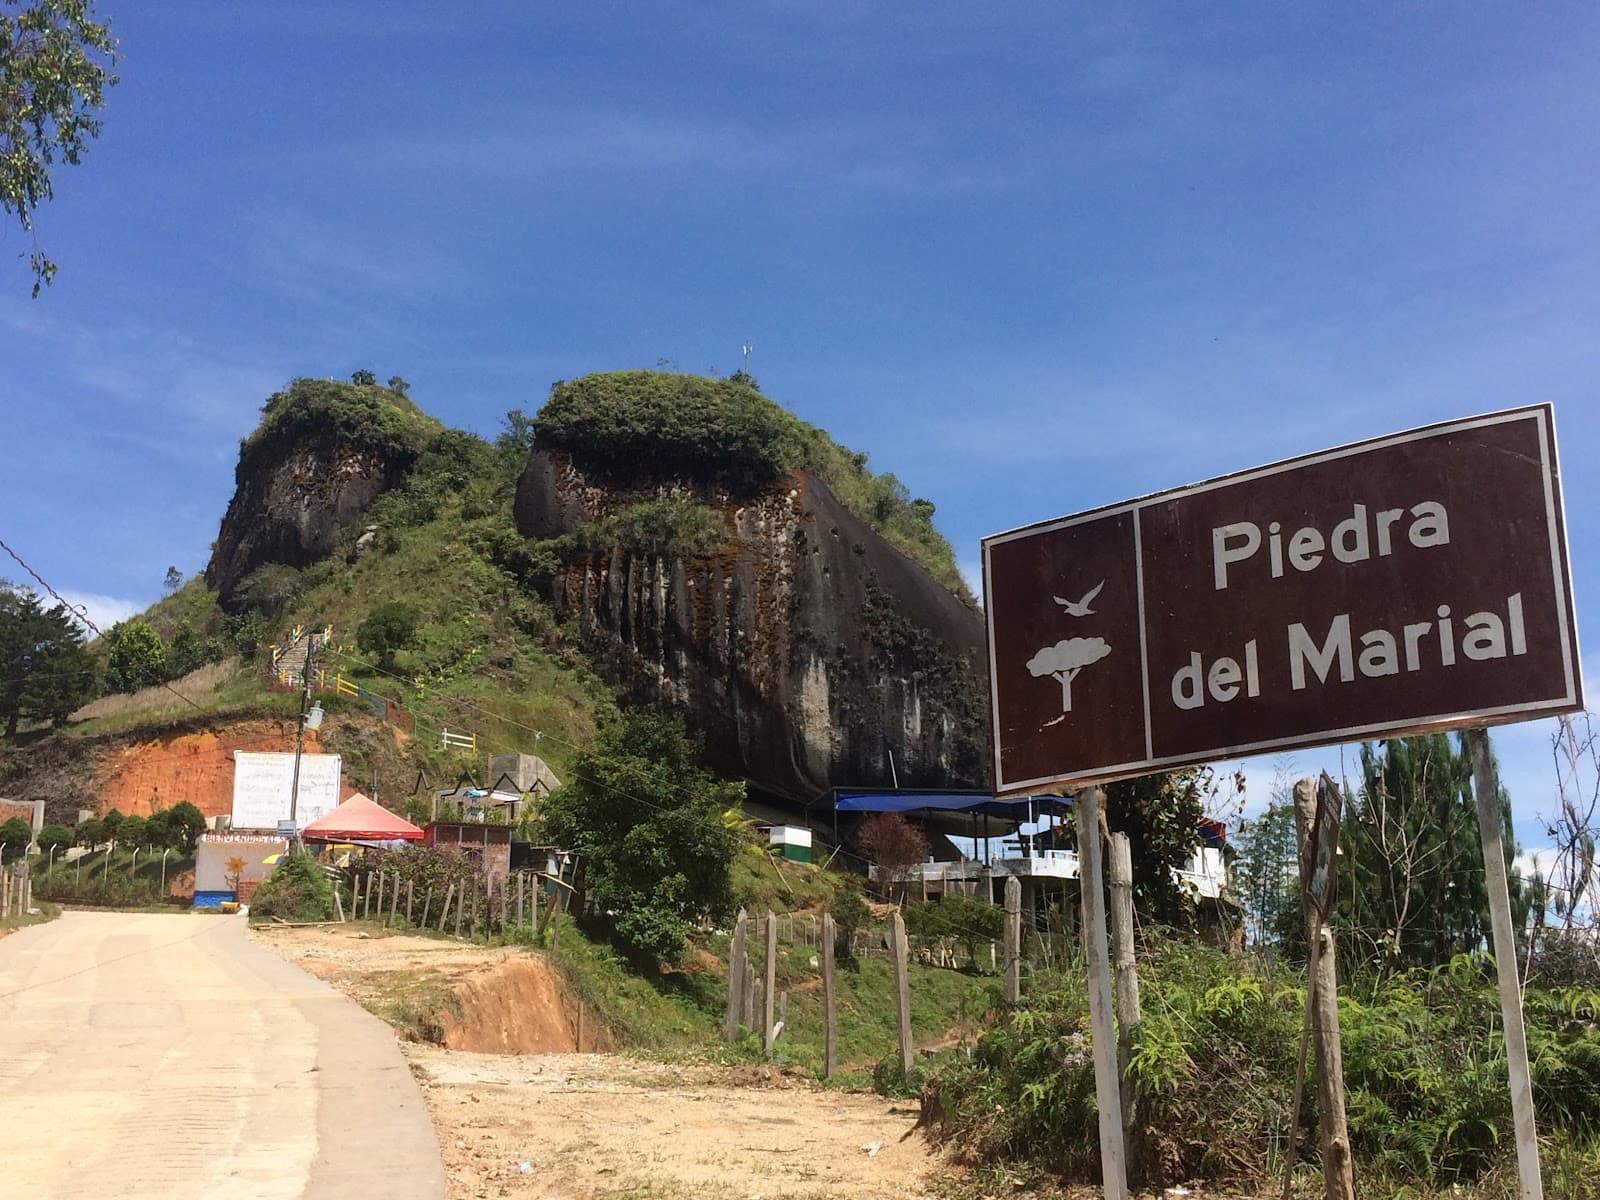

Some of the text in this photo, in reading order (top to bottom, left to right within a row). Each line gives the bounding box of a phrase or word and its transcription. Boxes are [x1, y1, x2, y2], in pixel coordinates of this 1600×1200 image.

[1213, 501, 1450, 590] Piedra
[1172, 592, 1528, 710] del Marial
